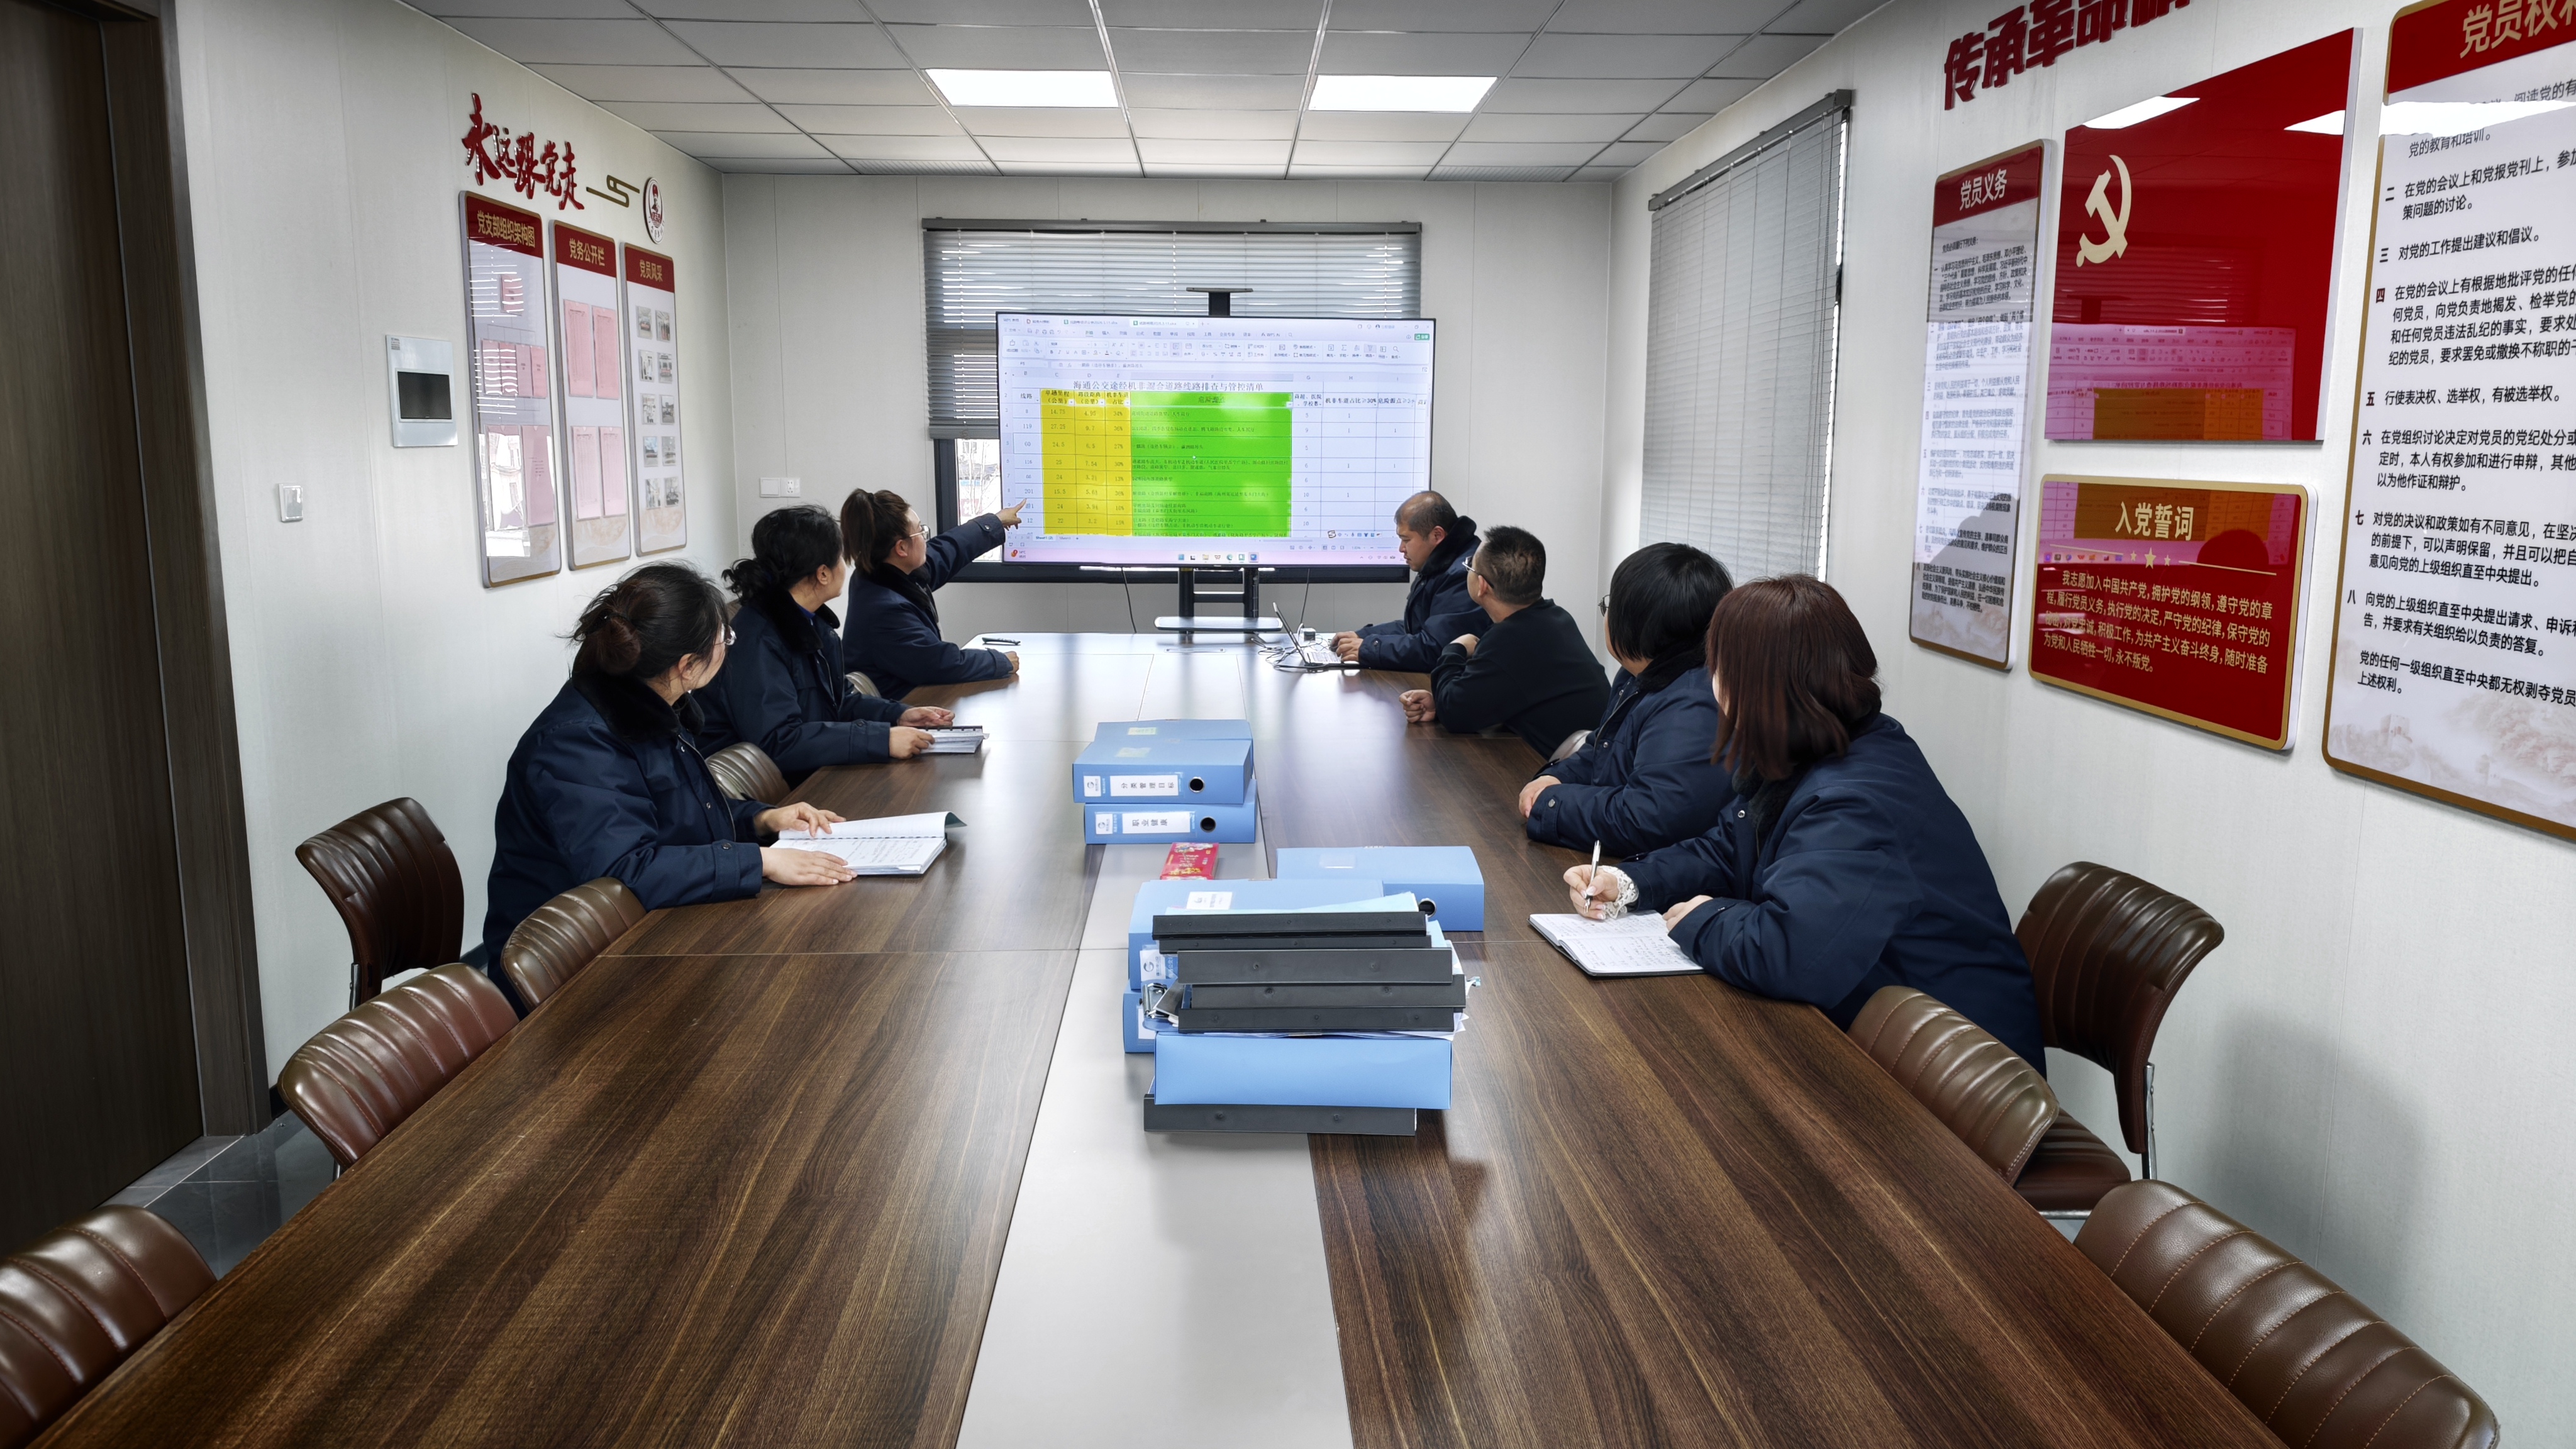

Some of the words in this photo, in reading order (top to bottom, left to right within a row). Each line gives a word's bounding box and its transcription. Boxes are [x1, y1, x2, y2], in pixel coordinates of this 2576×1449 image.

[1945, 0, 2190, 111] 传承革命
[462, 92, 584, 210] 永远跟党走
[1960, 169, 2007, 211] 党员义务
[2402, 194, 2472, 221] 策问题的讨论。
[477, 211, 536, 248] 党支部组织架构图
[2380, 248, 2389, 263] 三
[2398, 226, 2539, 260] 对党的工作提出建议和倡议。
[569, 238, 605, 267] 党务公开栏
[640, 259, 663, 282] 党员风采
[2376, 288, 2385, 303] 四
[2366, 392, 2375, 406] 五
[2385, 384, 2559, 406] 行使表决权、选举权，有被选举权。
[2362, 430, 2372, 445] 六
[2377, 473, 2466, 491] 以为他作证和辩护。
[2115, 501, 2194, 541] 入党誓词
[2355, 510, 2364, 525] 七
[2369, 553, 2538, 587] 意见向党的上级组织直至中央提出。
[2062, 570, 2273, 621] 我志愿加入中国共产党，拥护党的纲领，遵守党的章
[2347, 589, 2357, 604] 八
[2363, 613, 2543, 657] 告，并要求有关组织给以负责的答复。
[2043, 631, 2153, 673] 为党和人民牺牲一切，永不叛党。
[2358, 671, 2402, 694] 上述权利。
[2360, 650, 2576, 708] 党的任何一级组织直至中央都无权剥夺党员
[1132, 818, 1168, 827] 职业健康
